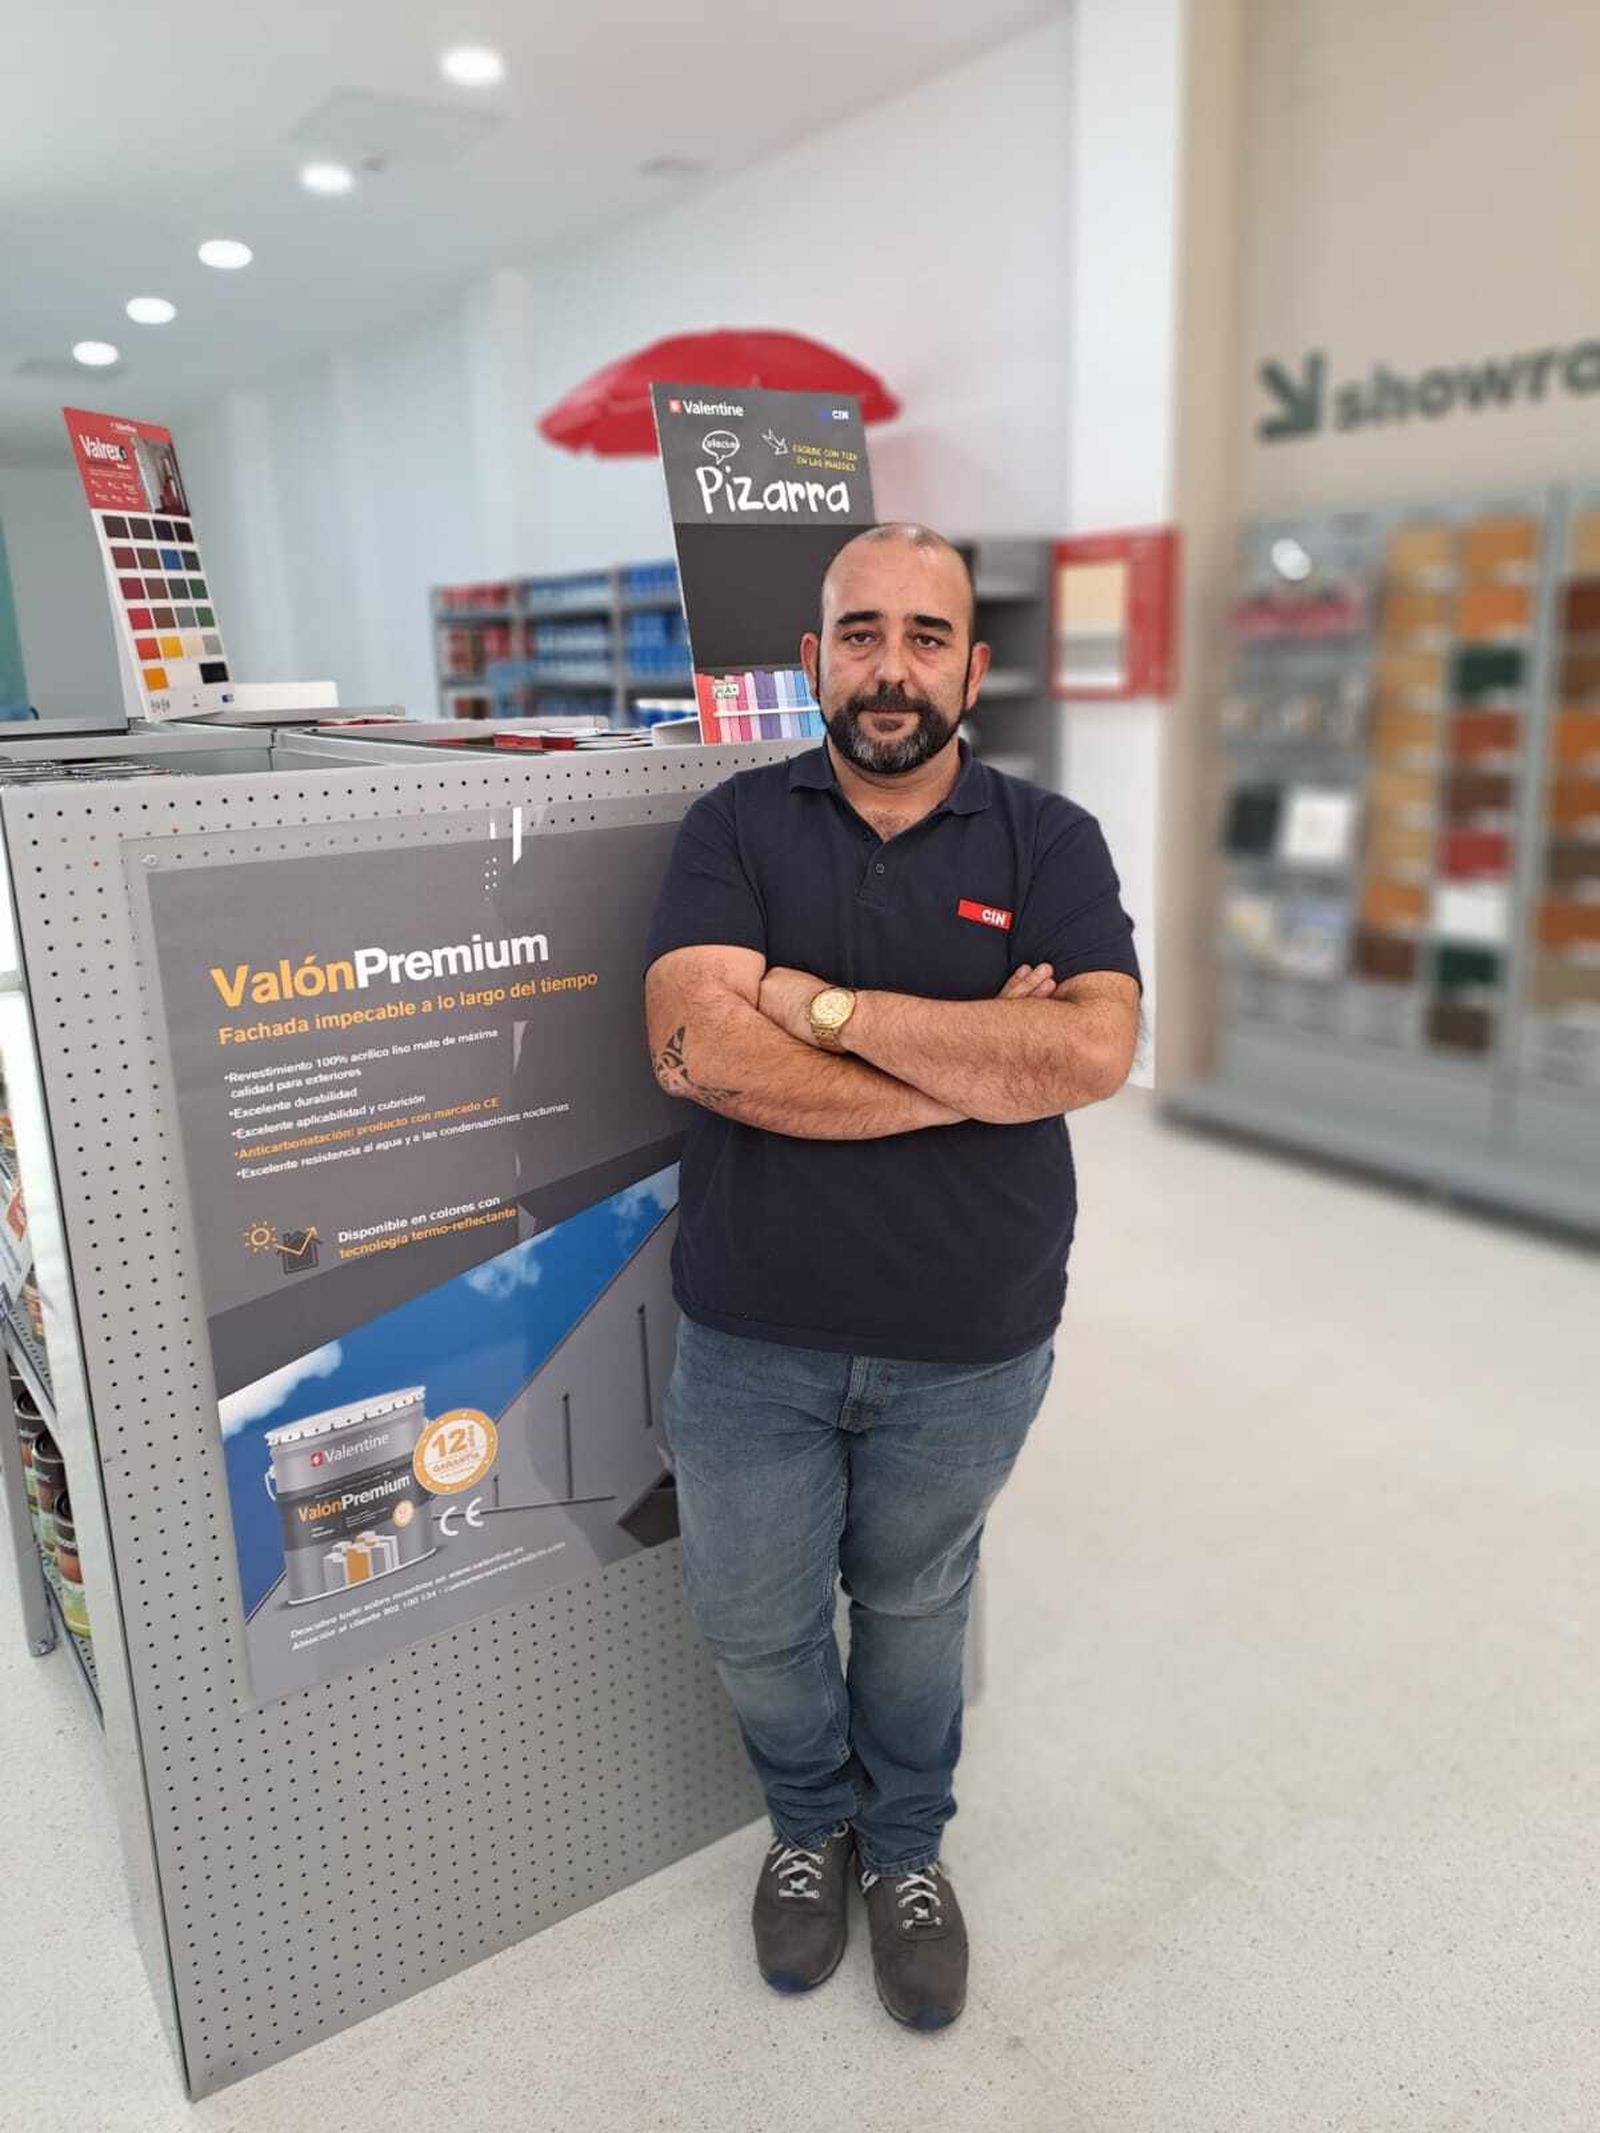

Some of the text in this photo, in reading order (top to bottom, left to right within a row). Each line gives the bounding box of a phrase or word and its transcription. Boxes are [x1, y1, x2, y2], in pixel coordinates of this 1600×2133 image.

[682, 400, 745, 417] Valentine
[696, 465, 850, 514] Pizarra
[981, 908, 1006, 927] CIN
[210, 933, 549, 1008] ValónPremium
[218, 972, 598, 1046] Fachada impecable a lo largo del tiempo
[317, 1054, 349, 1068] 100%
[391, 1044, 412, 1056] liso
[413, 1038, 441, 1052] mate
[442, 1034, 456, 1046] de
[230, 1067, 363, 1099] calidad para exteriores
[294, 1087, 358, 1108] durabilidad
[296, 1104, 367, 1129] aplicabilidad
[368, 1103, 377, 1115] y
[357, 1117, 409, 1138] producto
[410, 1112, 432, 1124] con
[434, 1101, 481, 1120] marcado
[482, 1097, 500, 1109] CE
[363, 1141, 374, 1153] al
[375, 1136, 403, 1151] agua
[404, 1135, 412, 1146] y
[412, 1132, 420, 1143] a
[422, 1128, 438, 1141] las
[337, 1196, 501, 1243] Disponible en colores con
[411, 1206, 517, 1243] termo-reflectante
[324, 1432, 390, 1463] Valentine
[432, 1428, 468, 1458] 12
